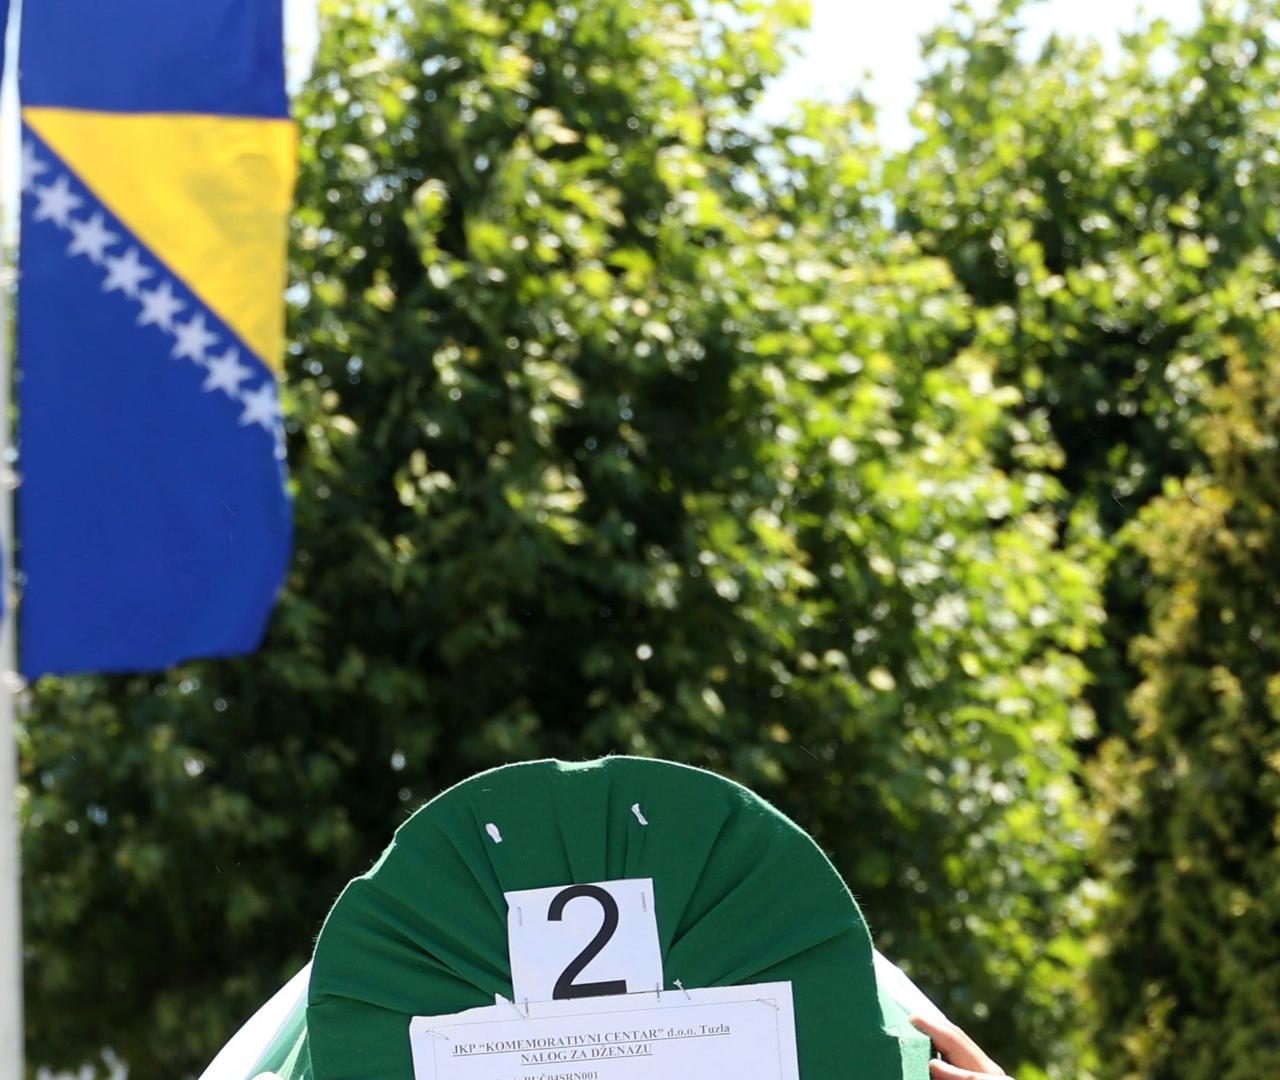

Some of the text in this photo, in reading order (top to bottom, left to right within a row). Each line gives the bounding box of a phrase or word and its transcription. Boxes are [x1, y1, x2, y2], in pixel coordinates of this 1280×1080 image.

[547, 884, 627, 1000] 2
[452, 1044, 476, 1055] JKP
[667, 1027, 696, 1037] d.o.o.
[699, 1023, 730, 1034] Tuzla
[521, 1043, 653, 1064] NALOG ZA DŽENAZU
